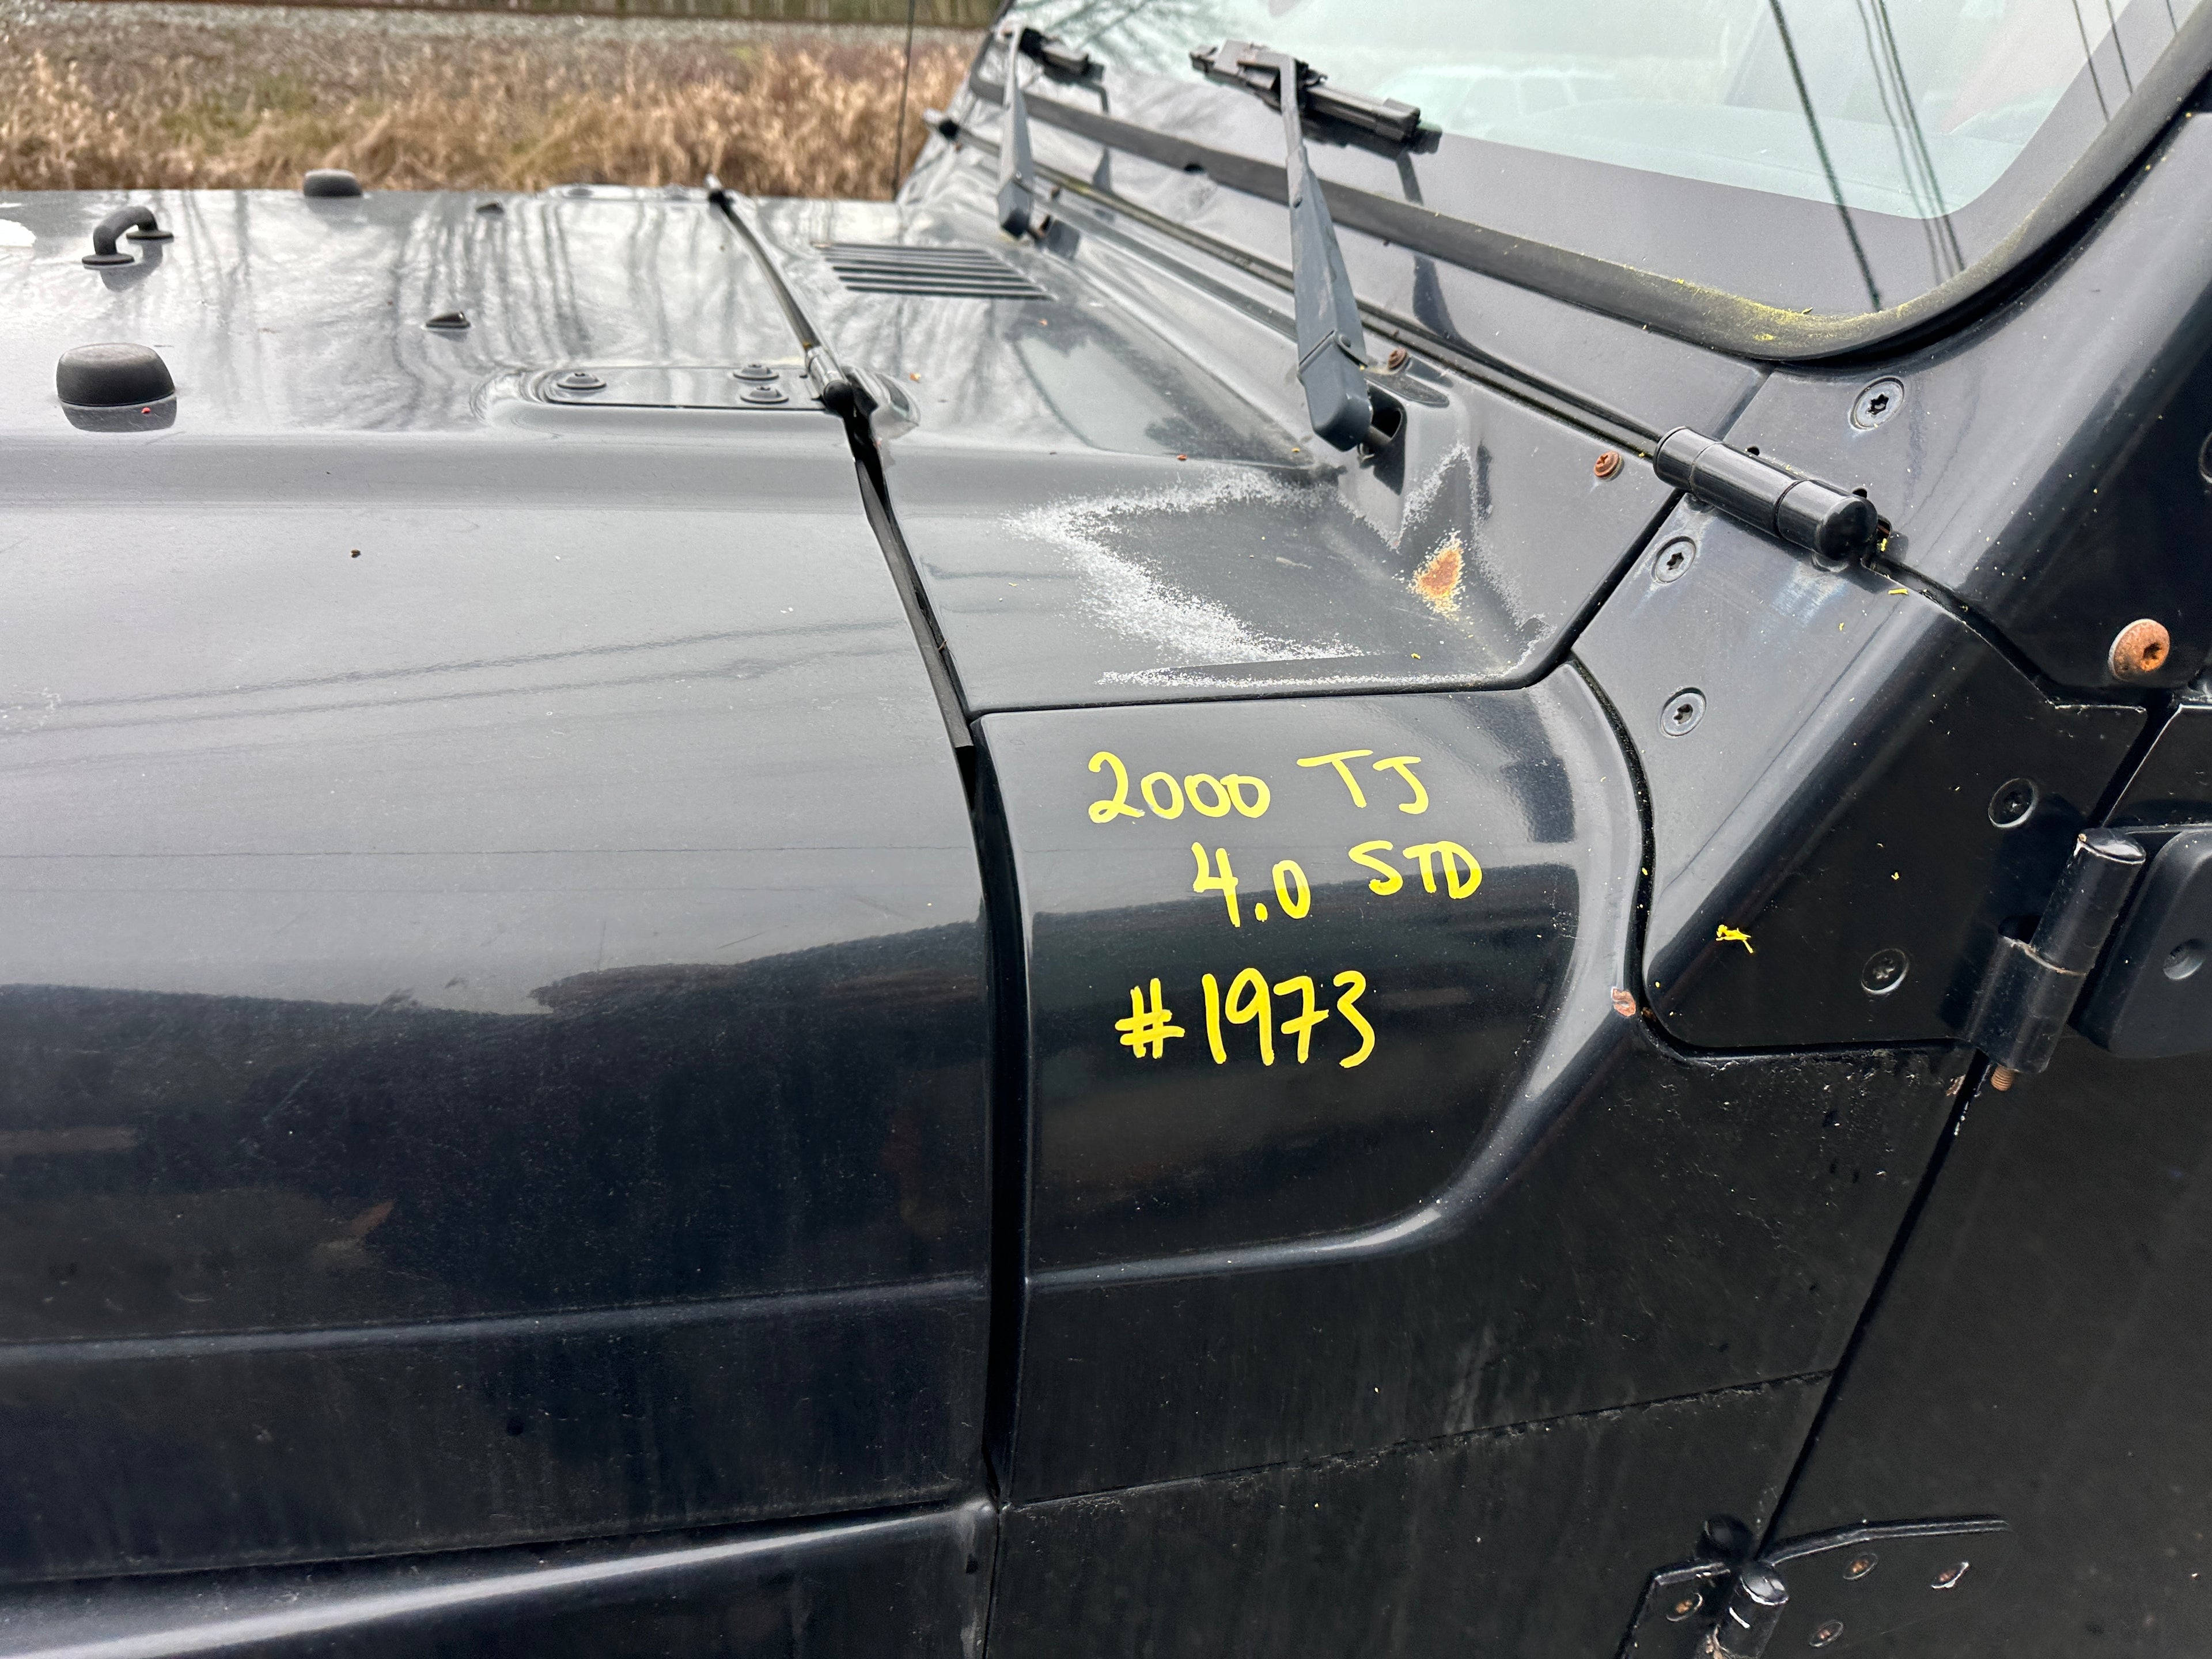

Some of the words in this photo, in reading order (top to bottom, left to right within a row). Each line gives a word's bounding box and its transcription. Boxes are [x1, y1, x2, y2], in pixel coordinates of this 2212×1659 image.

[1088, 751, 1271, 823] 2000
[1297, 749, 1430, 814] TJ
[1192, 842, 1311, 927] 4.0
[1349, 840, 1483, 899] STD
[1115, 968, 1376, 1068] #1973
